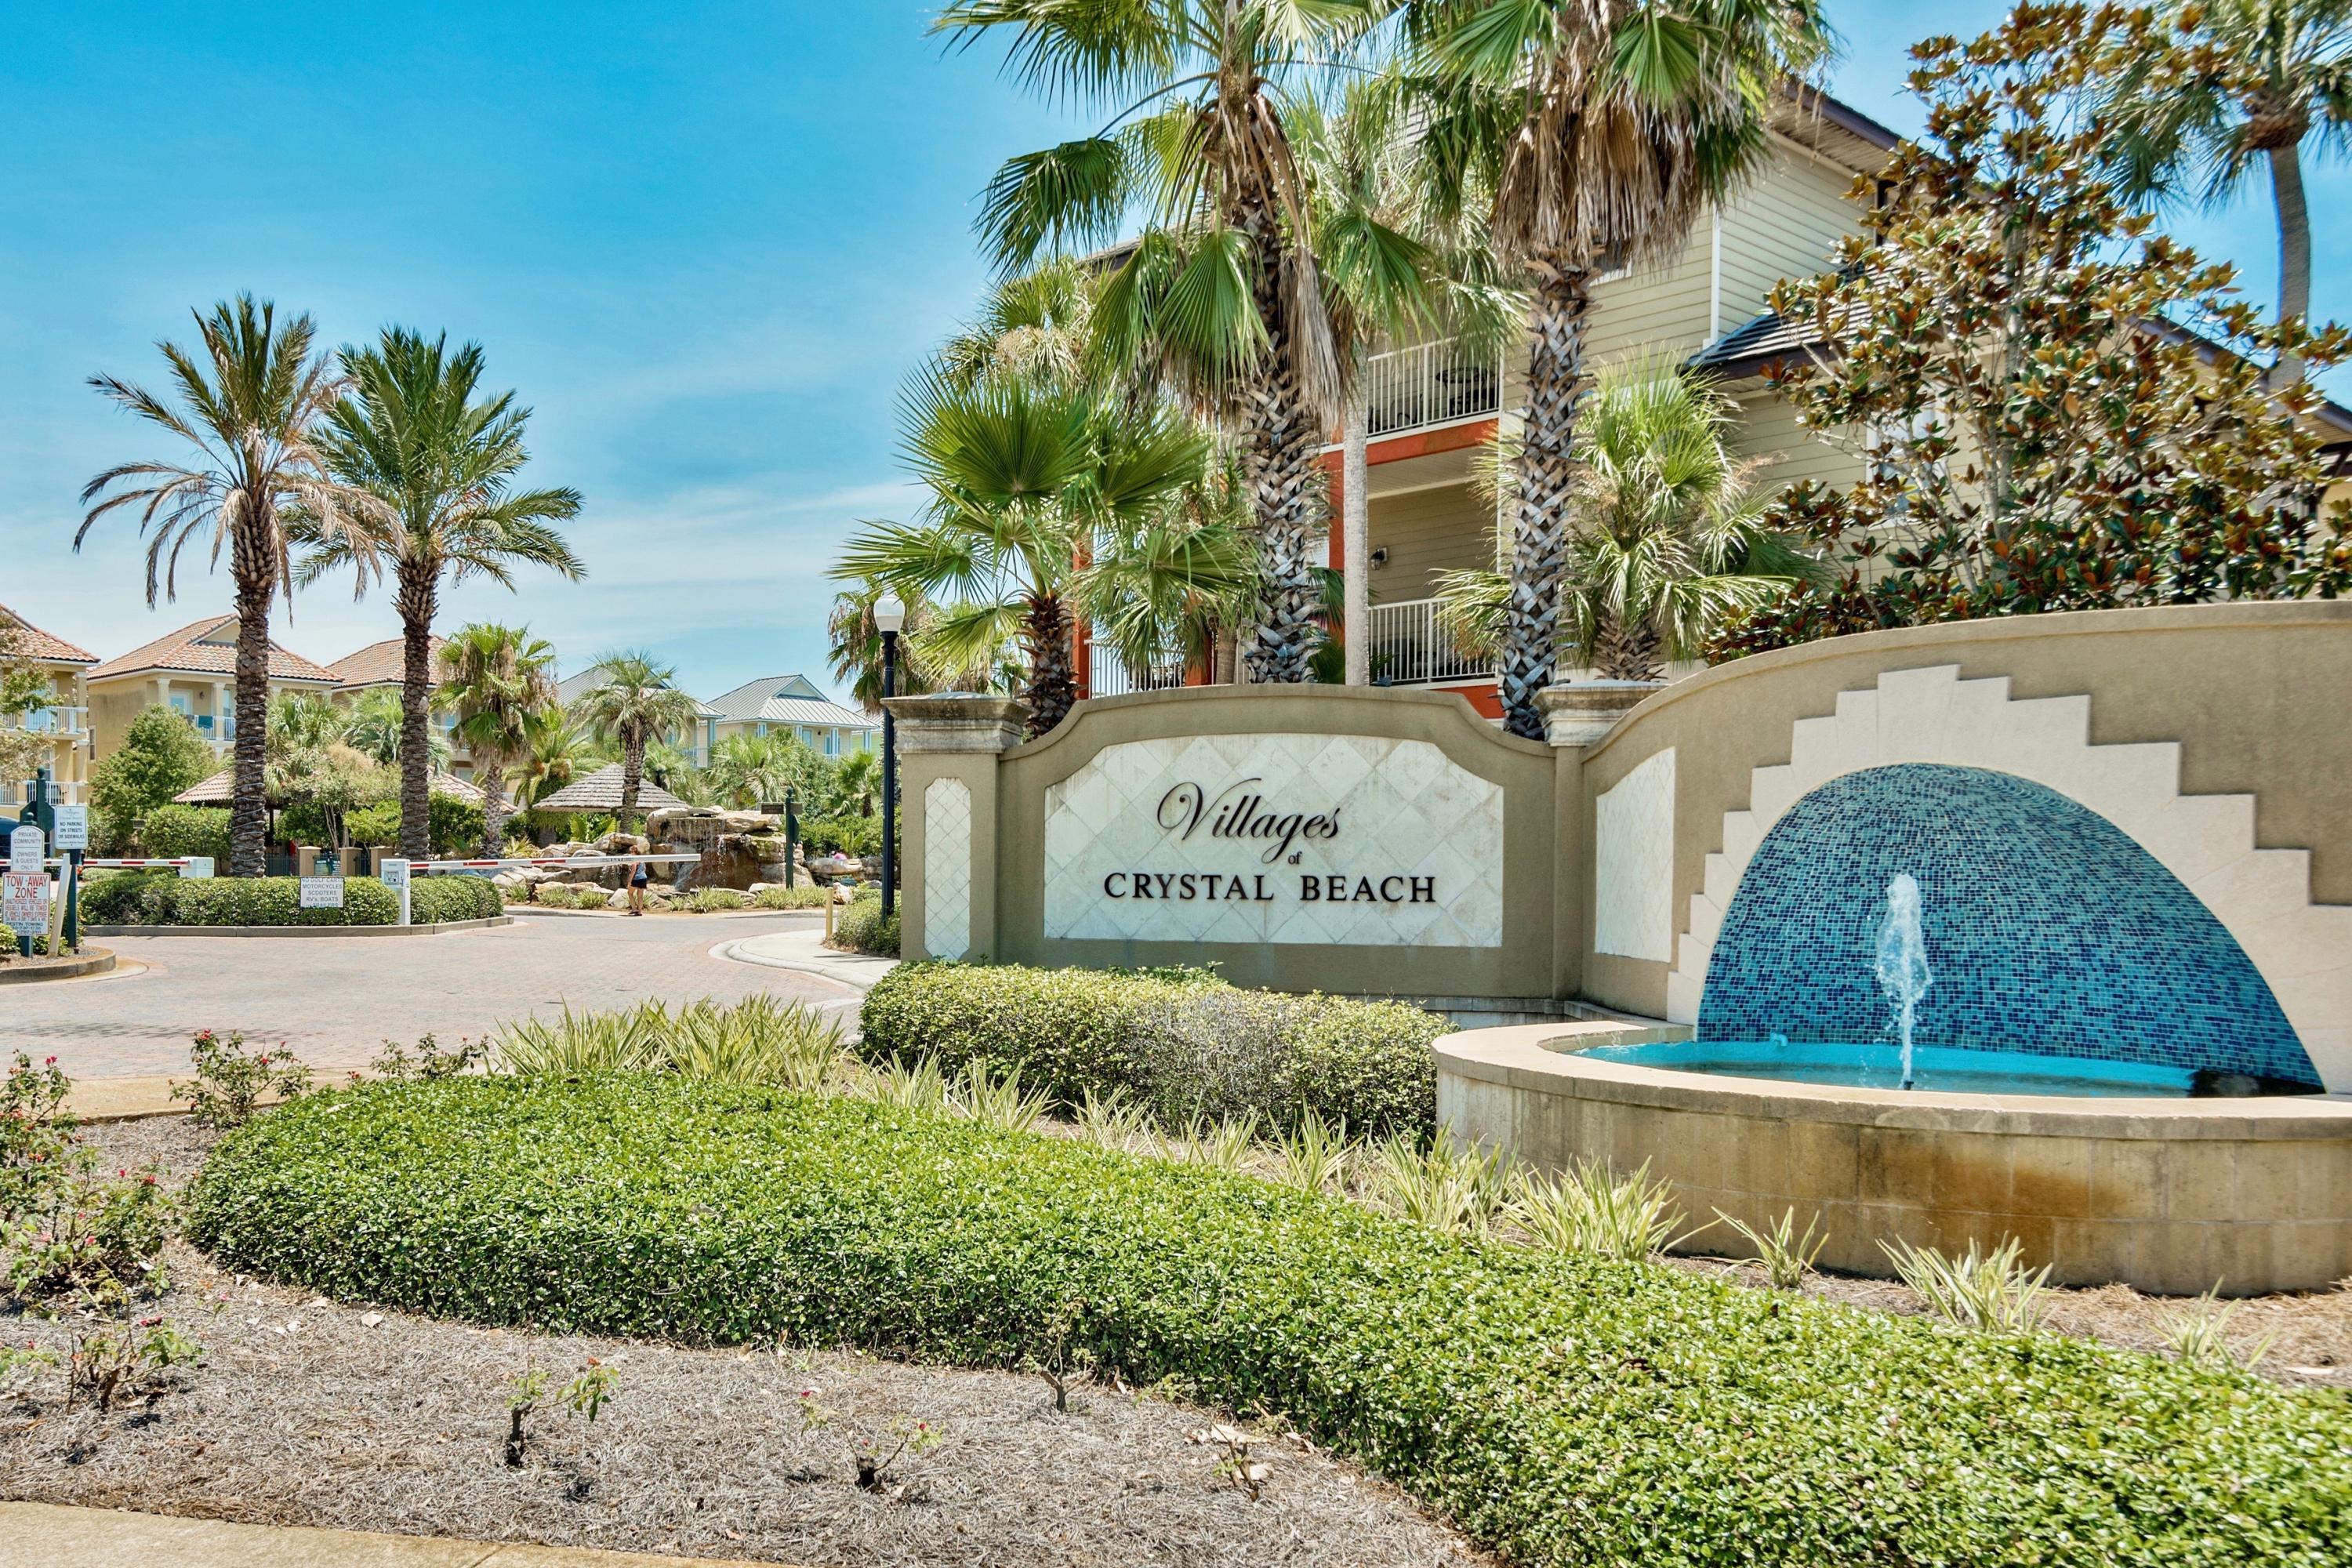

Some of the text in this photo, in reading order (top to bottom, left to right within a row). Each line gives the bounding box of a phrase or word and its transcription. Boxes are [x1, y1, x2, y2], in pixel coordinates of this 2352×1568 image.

[1156, 778, 1341, 863] Villages
[1287, 851, 1303, 866] of
[15, 887, 38, 898] ZONE
[1104, 872, 1436, 903] CRYSTAL BEACH
